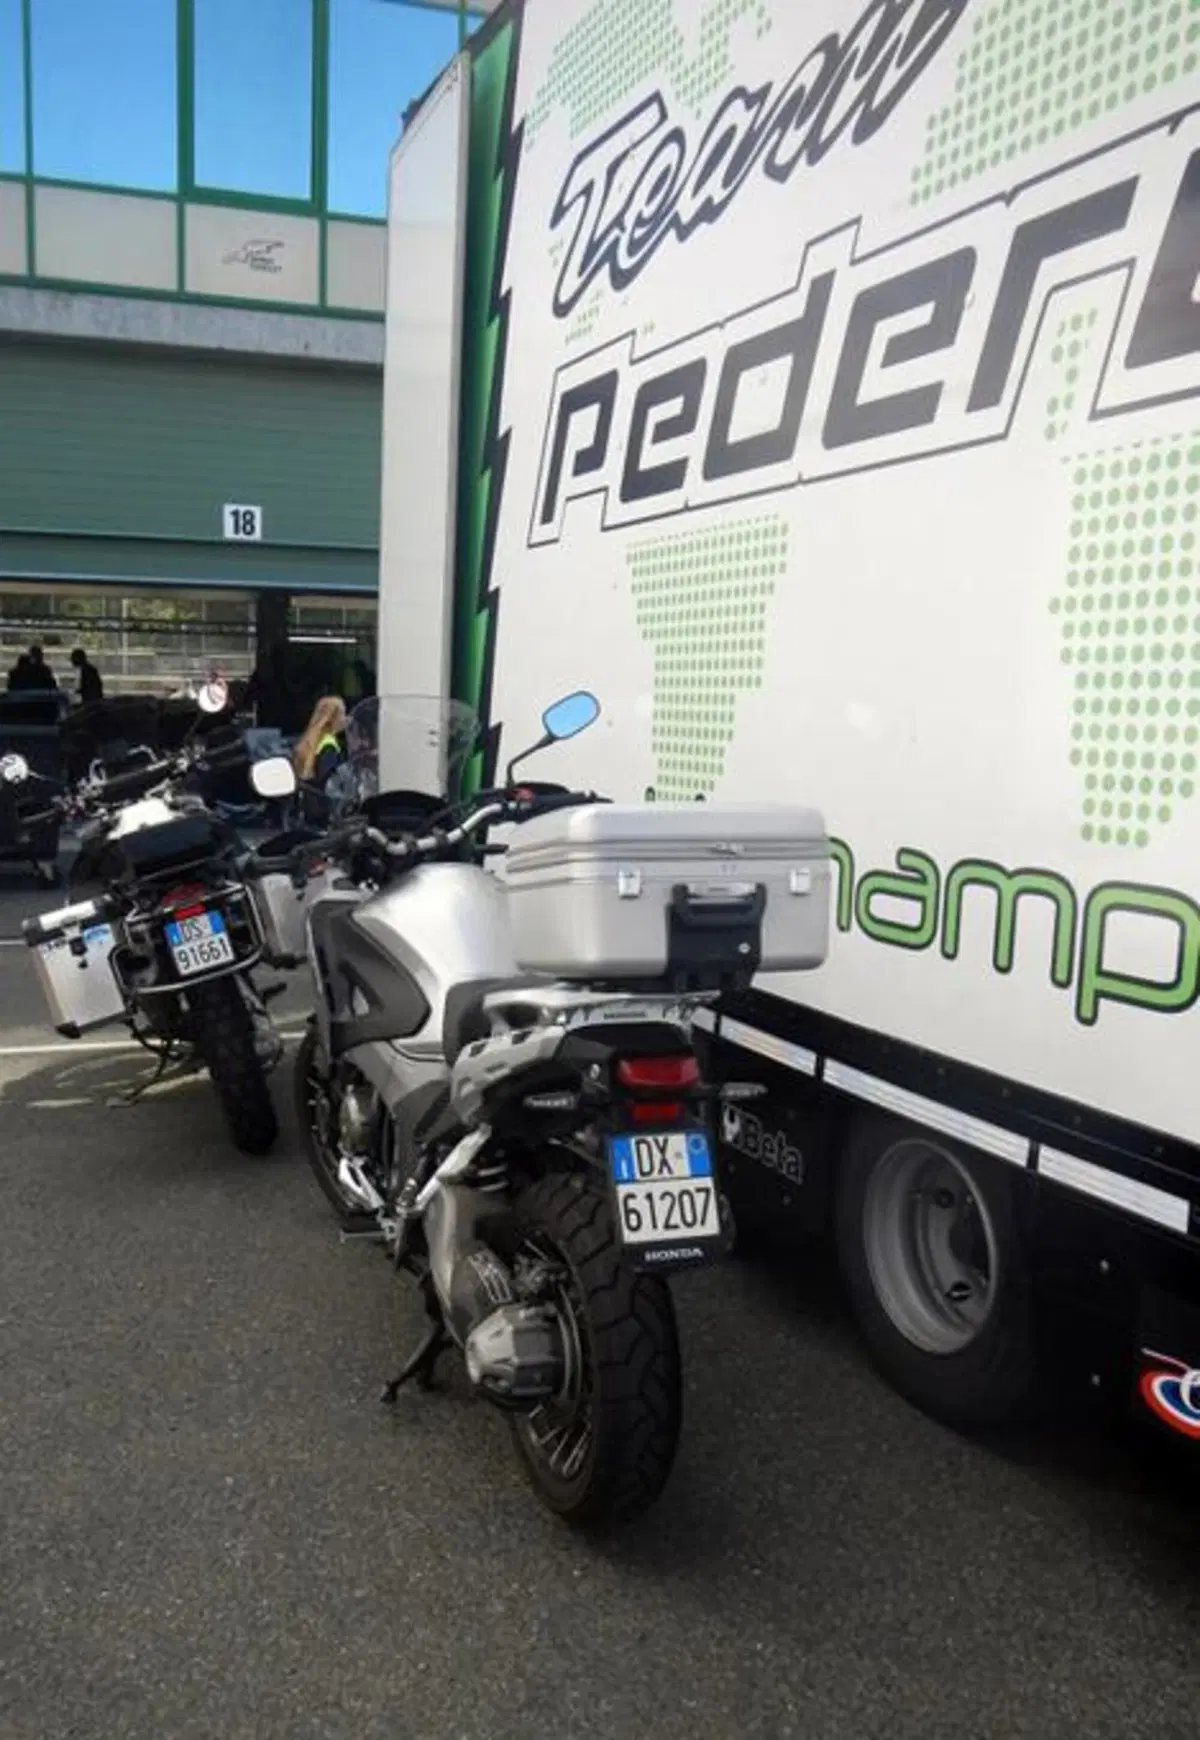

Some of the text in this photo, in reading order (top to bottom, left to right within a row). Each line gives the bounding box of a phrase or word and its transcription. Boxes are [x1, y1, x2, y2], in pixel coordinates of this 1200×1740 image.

[548, 0, 968, 318] Team
[230, 509, 255, 535] 18
[635, 1138, 673, 1177] DX
[623, 1187, 710, 1231] 61207
[644, 1248, 704, 1262] HONDA
